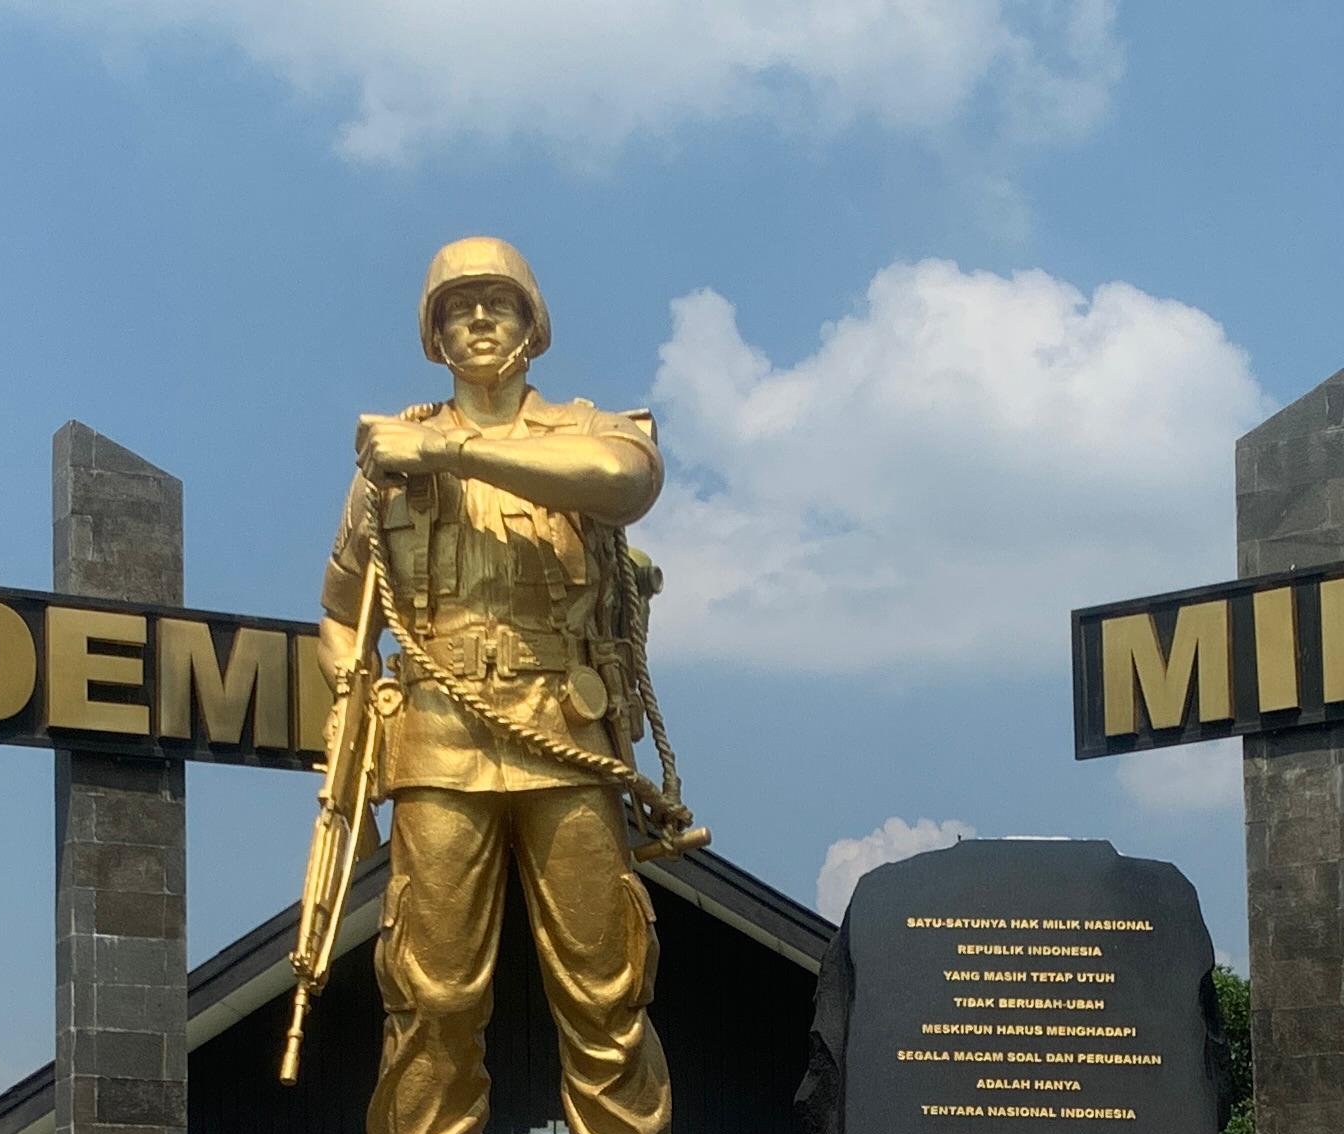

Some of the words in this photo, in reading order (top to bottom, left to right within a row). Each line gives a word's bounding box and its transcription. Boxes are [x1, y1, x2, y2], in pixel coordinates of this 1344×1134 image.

[907, 917, 1007, 930] SATU-SATUNYA
[1011, 919, 1039, 930] HAK
[1043, 919, 1080, 930] MILIK
[1084, 920, 1153, 932] NASIONAL
[958, 945, 1024, 956] REPUBLIK
[1028, 945, 1102, 957] INDONESIA
[943, 971, 980, 982] YANG
[984, 971, 1027, 982] MASIH
[1031, 972, 1073, 983] TETAP
[1077, 972, 1115, 983] UTUH
[954, 997, 995, 1009] TIDAK
[999, 998, 1104, 1010] BERUBAH-UBAH
[922, 1024, 993, 1035] MESKIPUN
[997, 1025, 1043, 1036] HARUS
[1047, 1025, 1136, 1037] MENGHADAPI
[897, 1050, 950, 1062] SEGALA
[954, 1051, 1004, 1063] MACAM
[1007, 1052, 1042, 1063] SOAL
[1046, 1053, 1074, 1063] DAN
[1078, 1053, 1161, 1065] PERUBAHAN
[977, 1079, 1030, 1090] ADALAH
[1035, 1080, 1081, 1091] HANYA
[921, 1106, 984, 1117] TENTARA
[988, 1106, 1057, 1118] NASIONAL
[1061, 1108, 1136, 1119] INDONESIA
